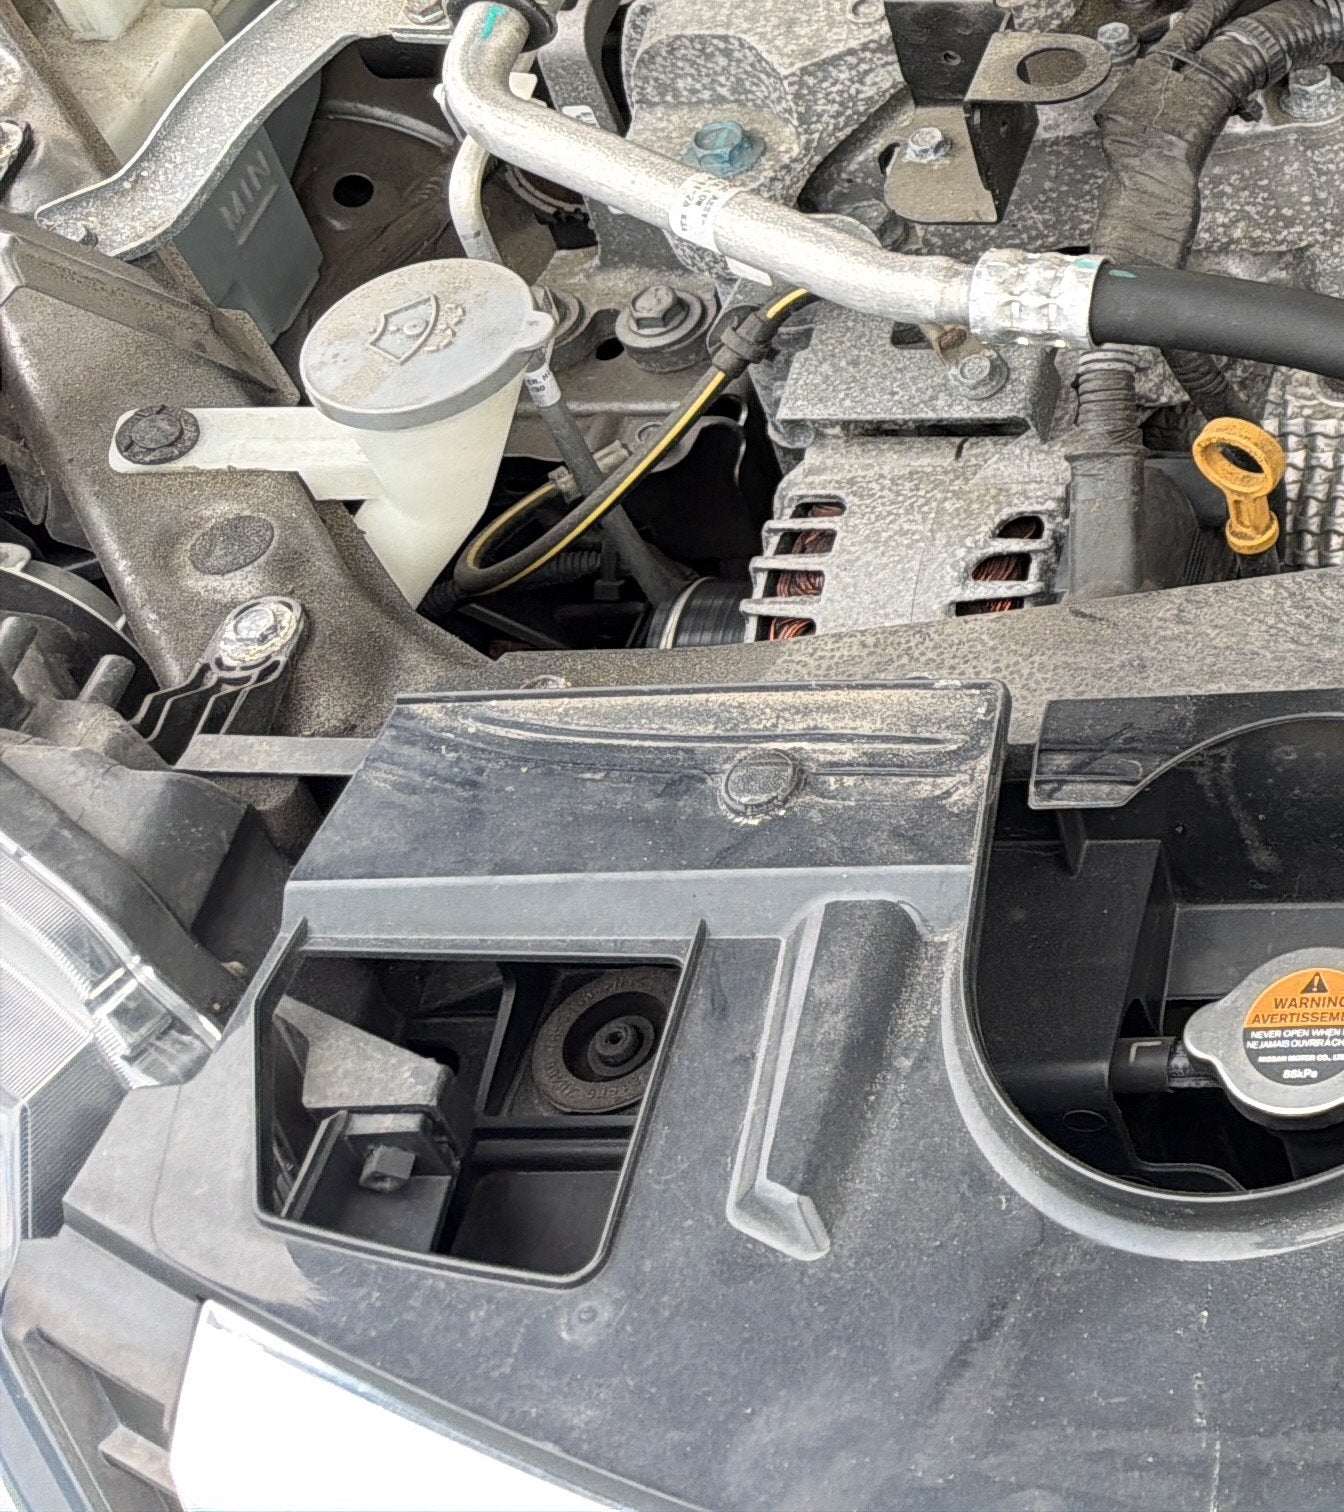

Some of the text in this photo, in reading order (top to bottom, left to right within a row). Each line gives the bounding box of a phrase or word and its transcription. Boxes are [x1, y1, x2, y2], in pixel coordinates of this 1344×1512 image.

[220, 149, 272, 232] MIN
[1250, 1029, 1282, 1038] NEVER
[1283, 1028, 1310, 1038] OPEN
[1311, 1028, 1341, 1037] WHEN
[1246, 1040, 1260, 1049] NE
[1260, 1039, 1290, 1049] JAMAIS
[1291, 1039, 1324, 1048] OUVRIR
[1288, 1054, 1316, 1062] MOTOR
